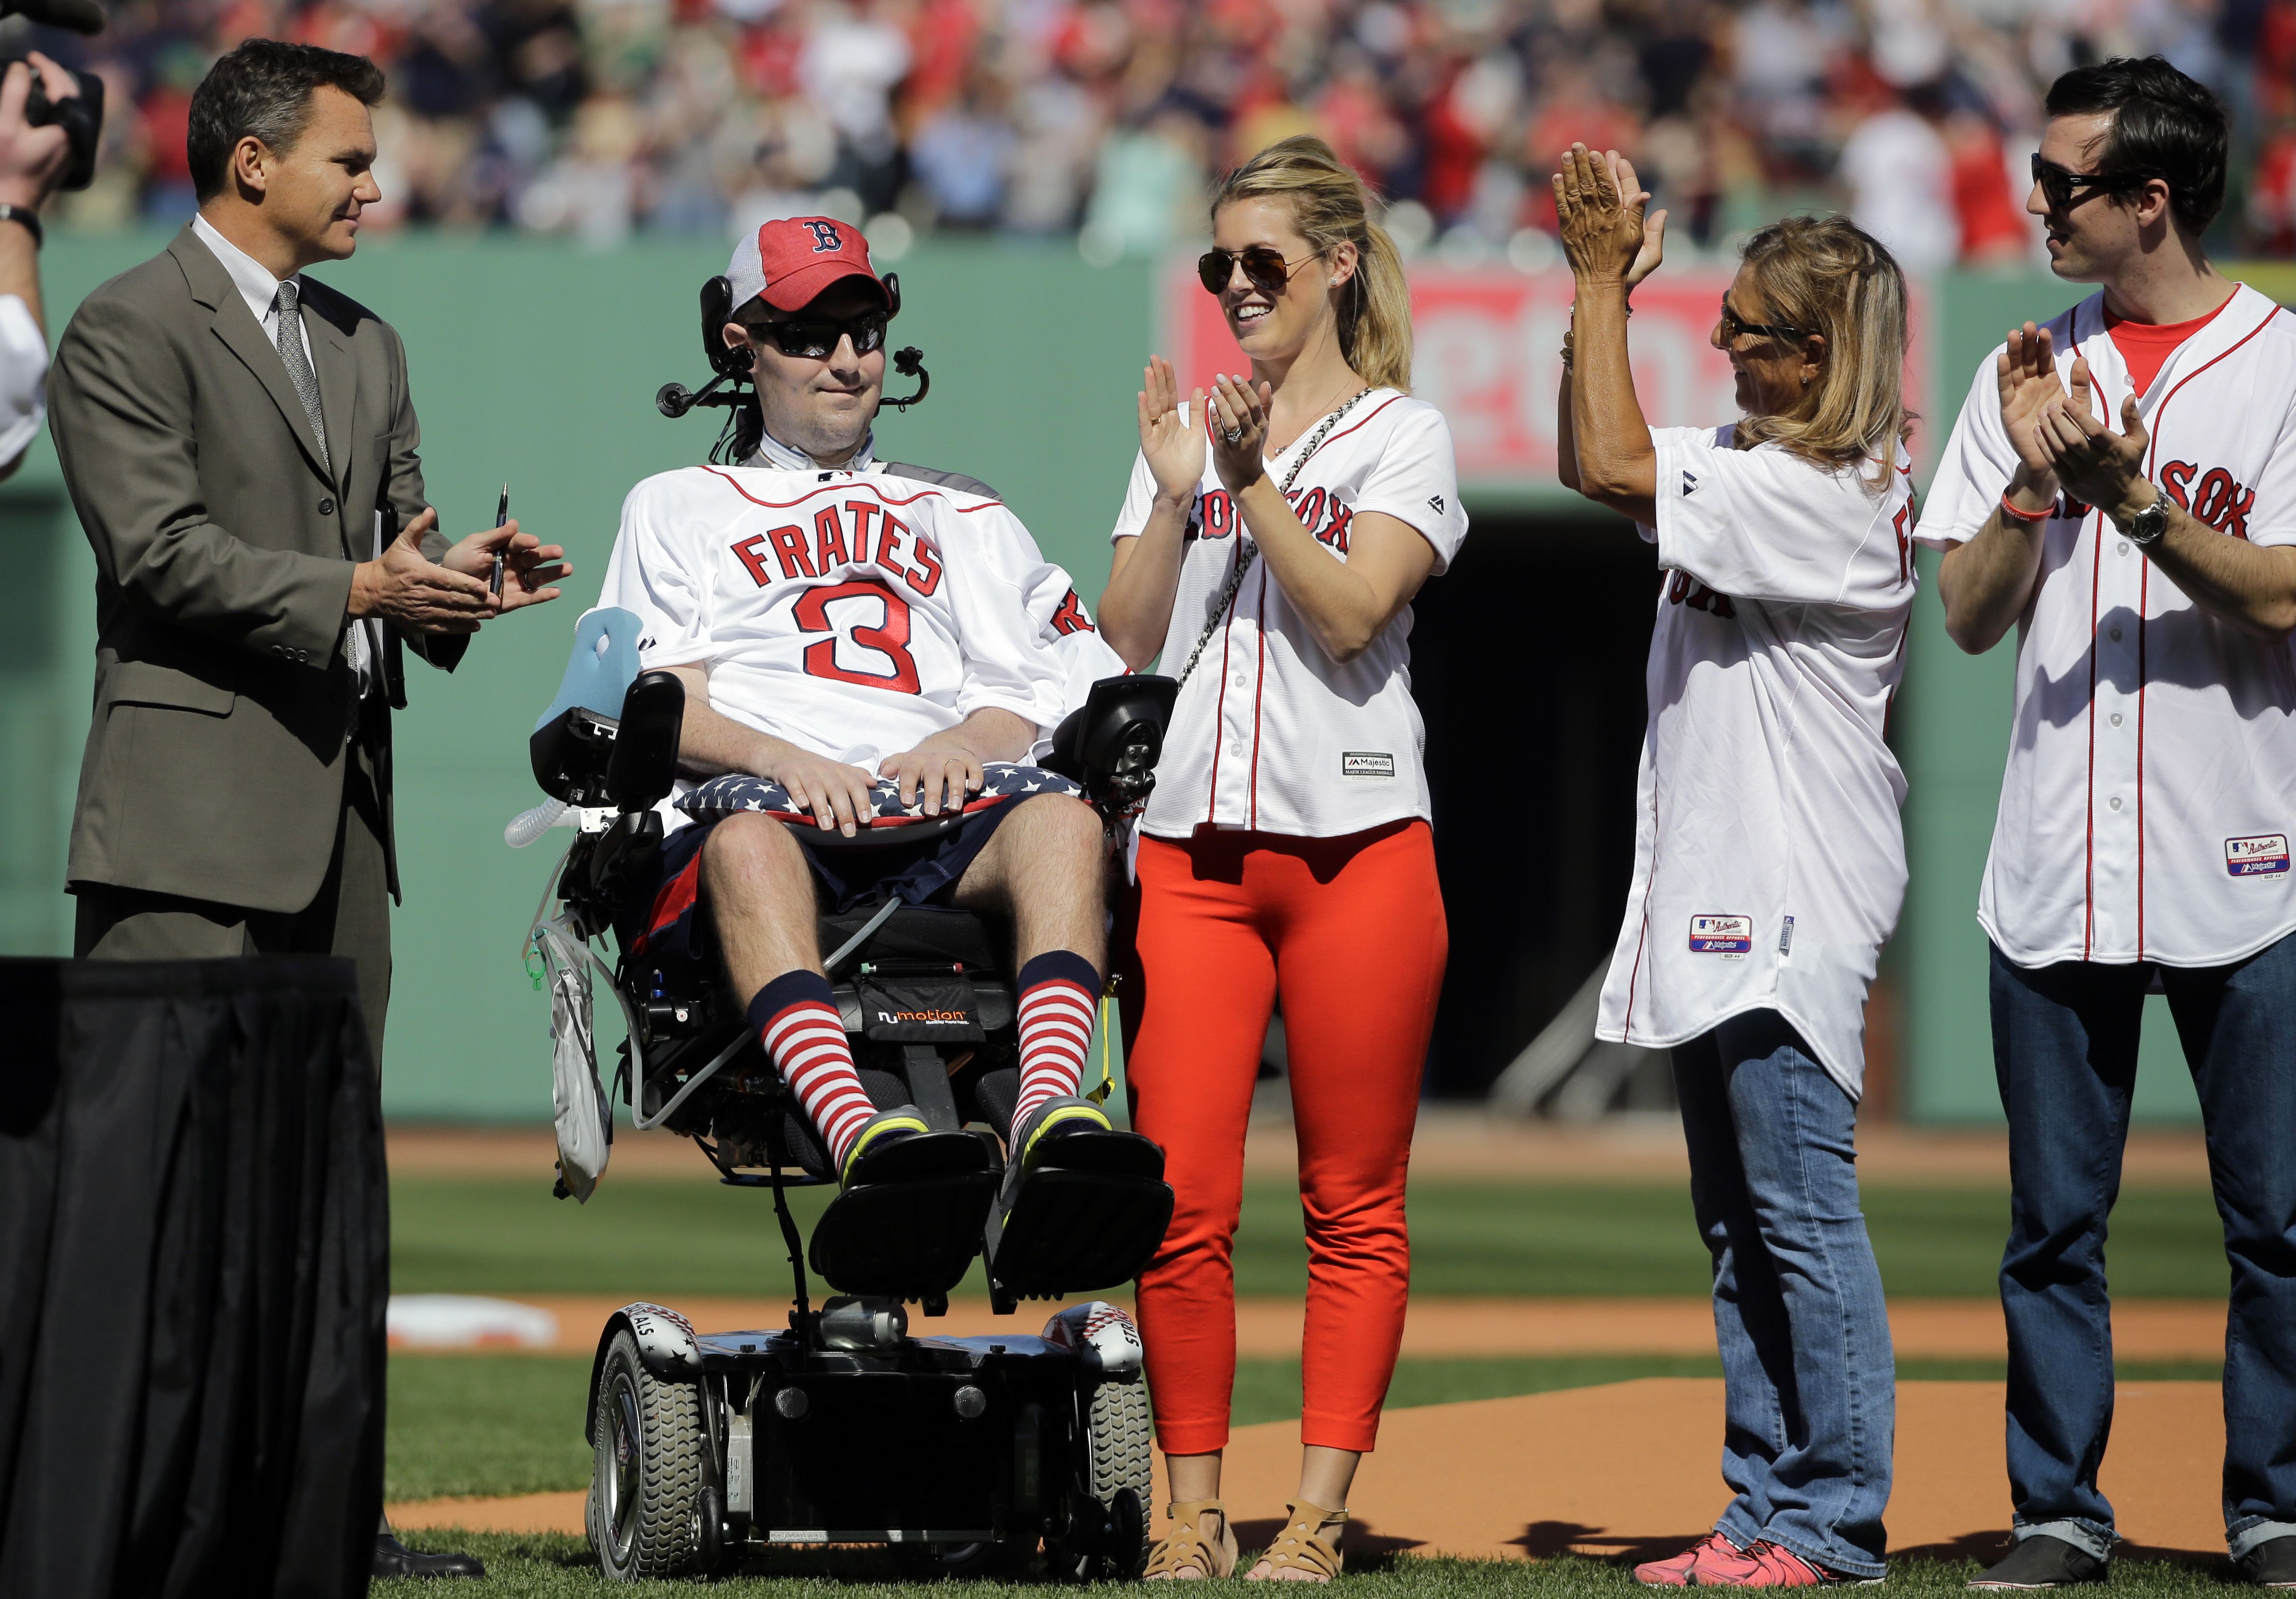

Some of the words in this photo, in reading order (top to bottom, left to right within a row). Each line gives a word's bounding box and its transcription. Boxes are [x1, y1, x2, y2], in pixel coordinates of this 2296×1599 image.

[803, 221, 842, 252] B
[729, 500, 943, 597] FRATES
[791, 579, 921, 695] 3
[1361, 759, 1390, 768] Majestic
[2248, 839, 2277, 855] Authentic
[2251, 862, 2276, 871] Majestic
[1713, 919, 1742, 932] Authentic
[1714, 941, 1737, 950] Majestic
[634, 1317, 654, 1336] ALS
